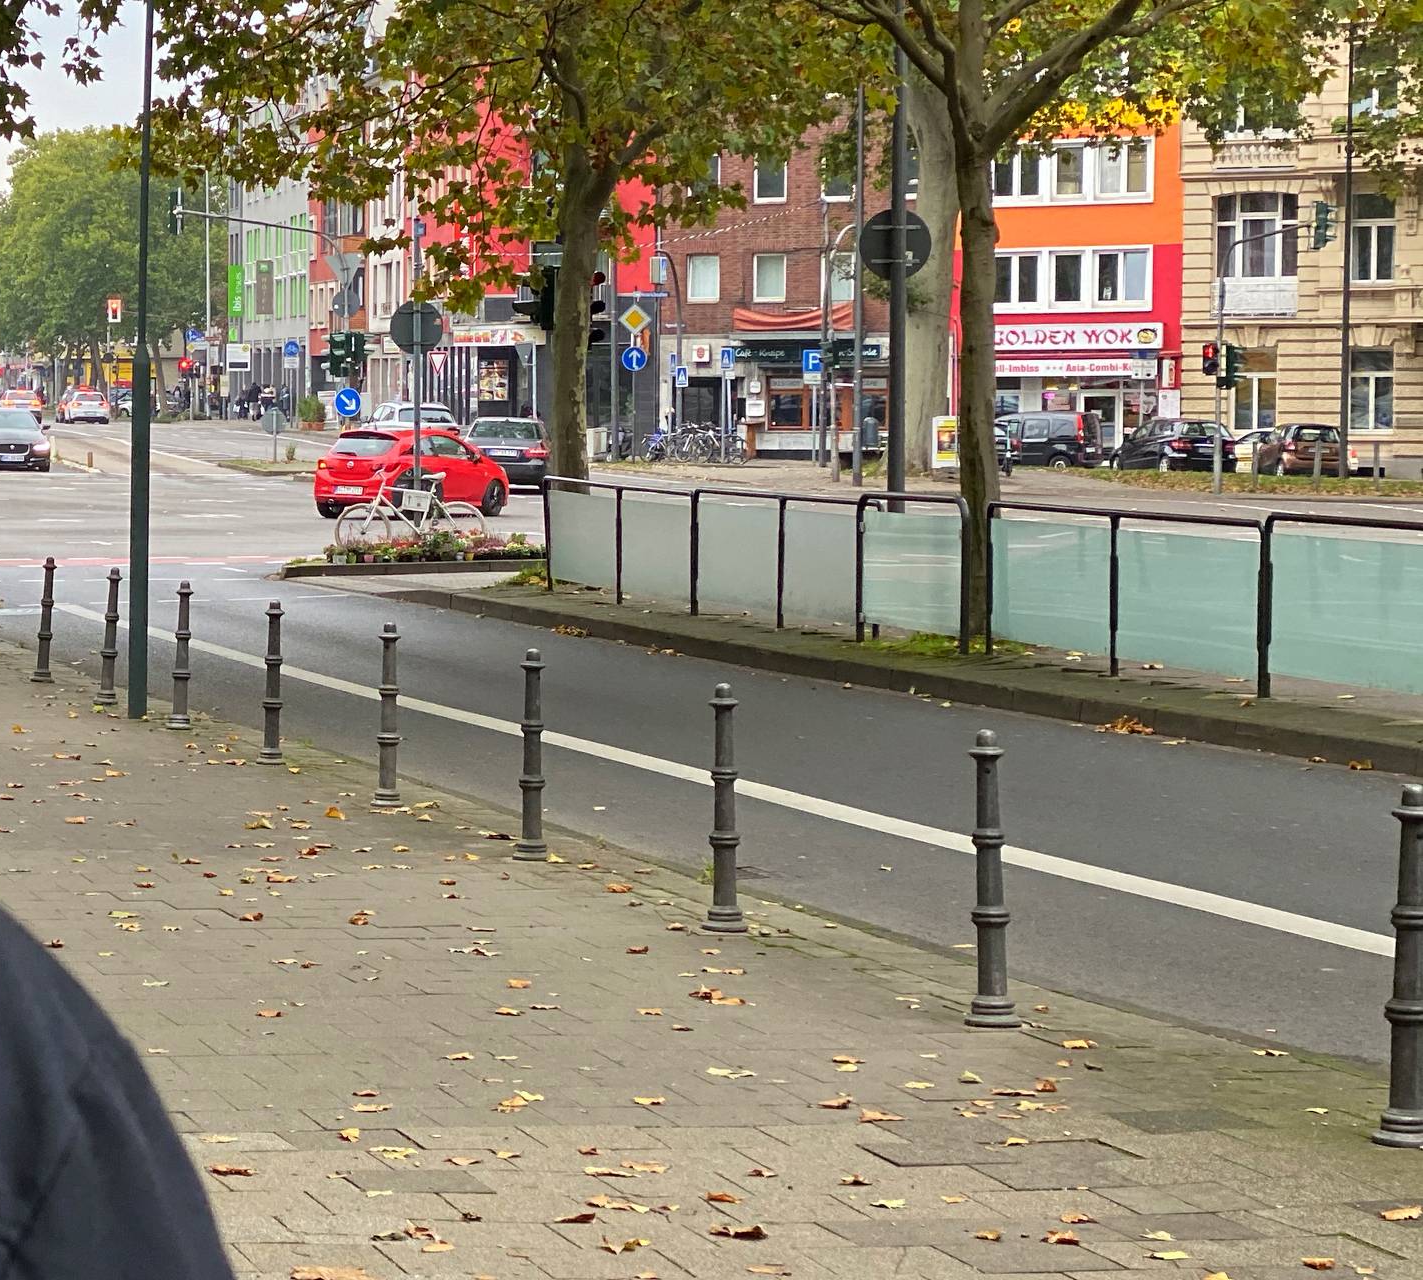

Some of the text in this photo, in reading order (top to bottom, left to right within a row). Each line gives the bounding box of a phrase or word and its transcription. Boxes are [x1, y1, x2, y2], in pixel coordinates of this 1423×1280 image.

[994, 329, 1133, 345] GOLDEN WOK
[808, 353, 821, 370] P
